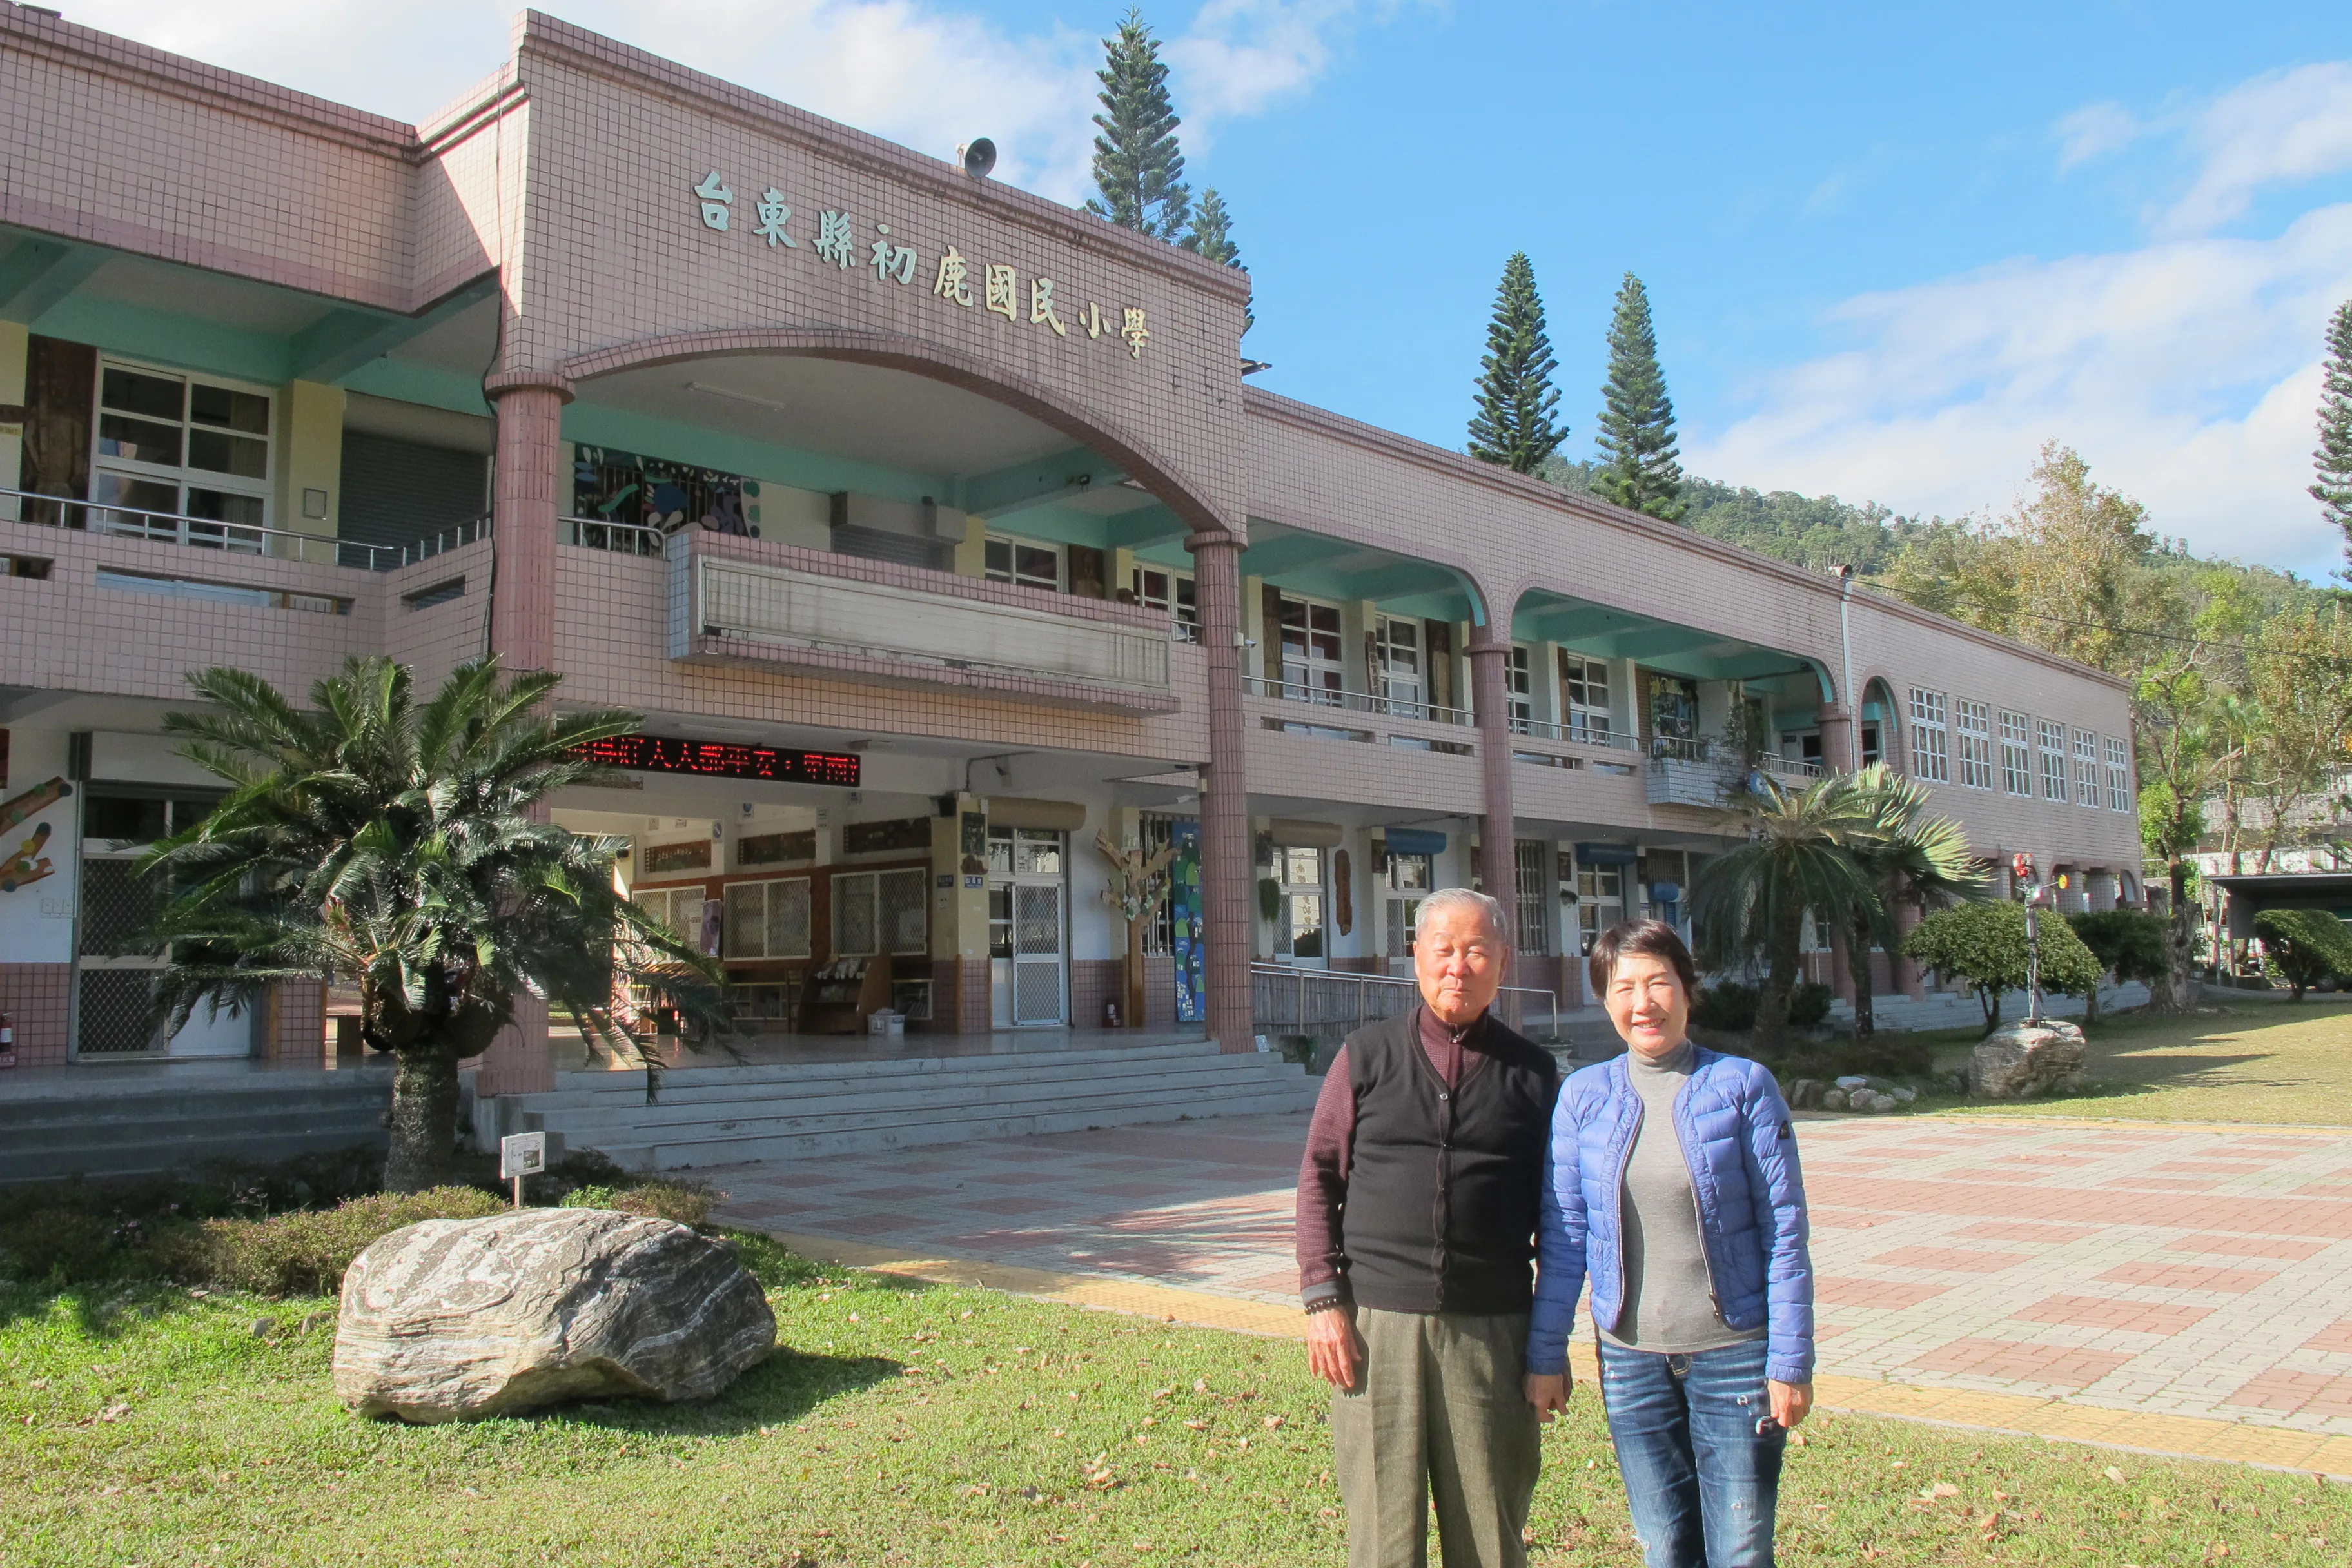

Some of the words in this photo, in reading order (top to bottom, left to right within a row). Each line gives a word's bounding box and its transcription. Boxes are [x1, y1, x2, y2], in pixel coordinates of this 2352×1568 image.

[694, 170, 1150, 359] 台東縣初鹿國民小學
